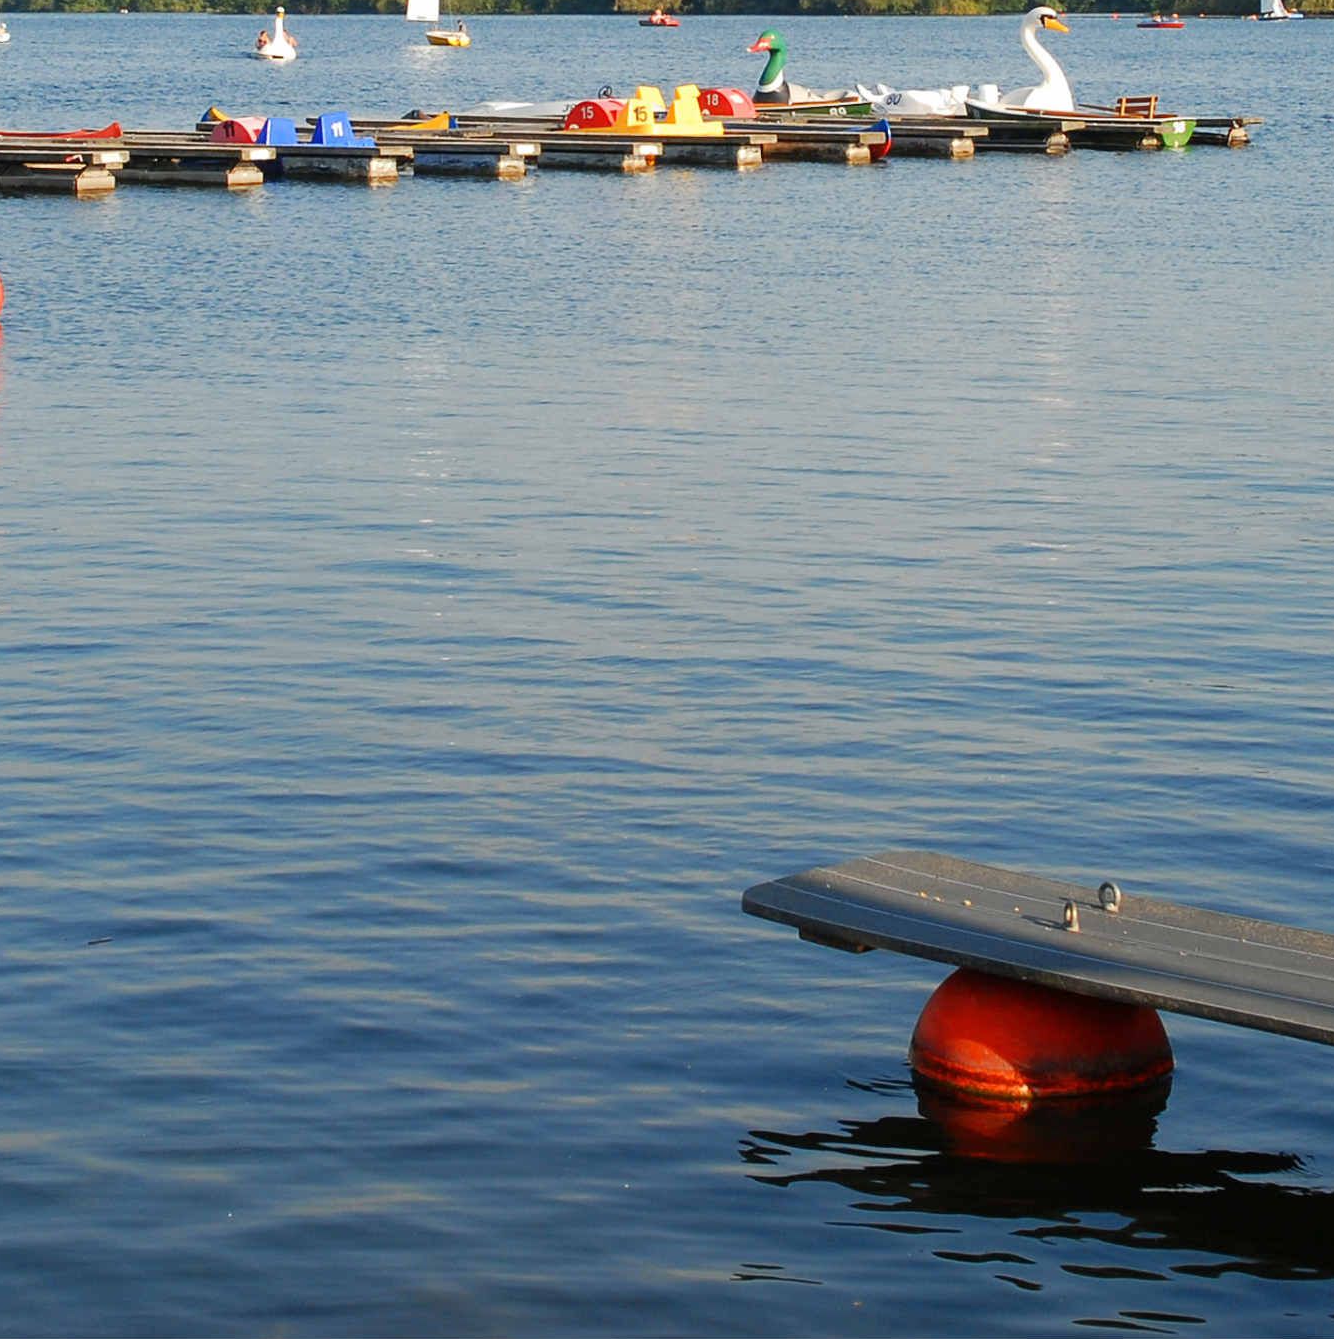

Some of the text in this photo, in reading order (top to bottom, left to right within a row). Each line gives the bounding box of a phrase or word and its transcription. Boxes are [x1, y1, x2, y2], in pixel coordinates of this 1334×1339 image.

[707, 94, 719, 106] 18
[581, 106, 594, 119] 15
[633, 105, 648, 122] 15
[223, 121, 234, 138] 11
[331, 121, 343, 137] 11
